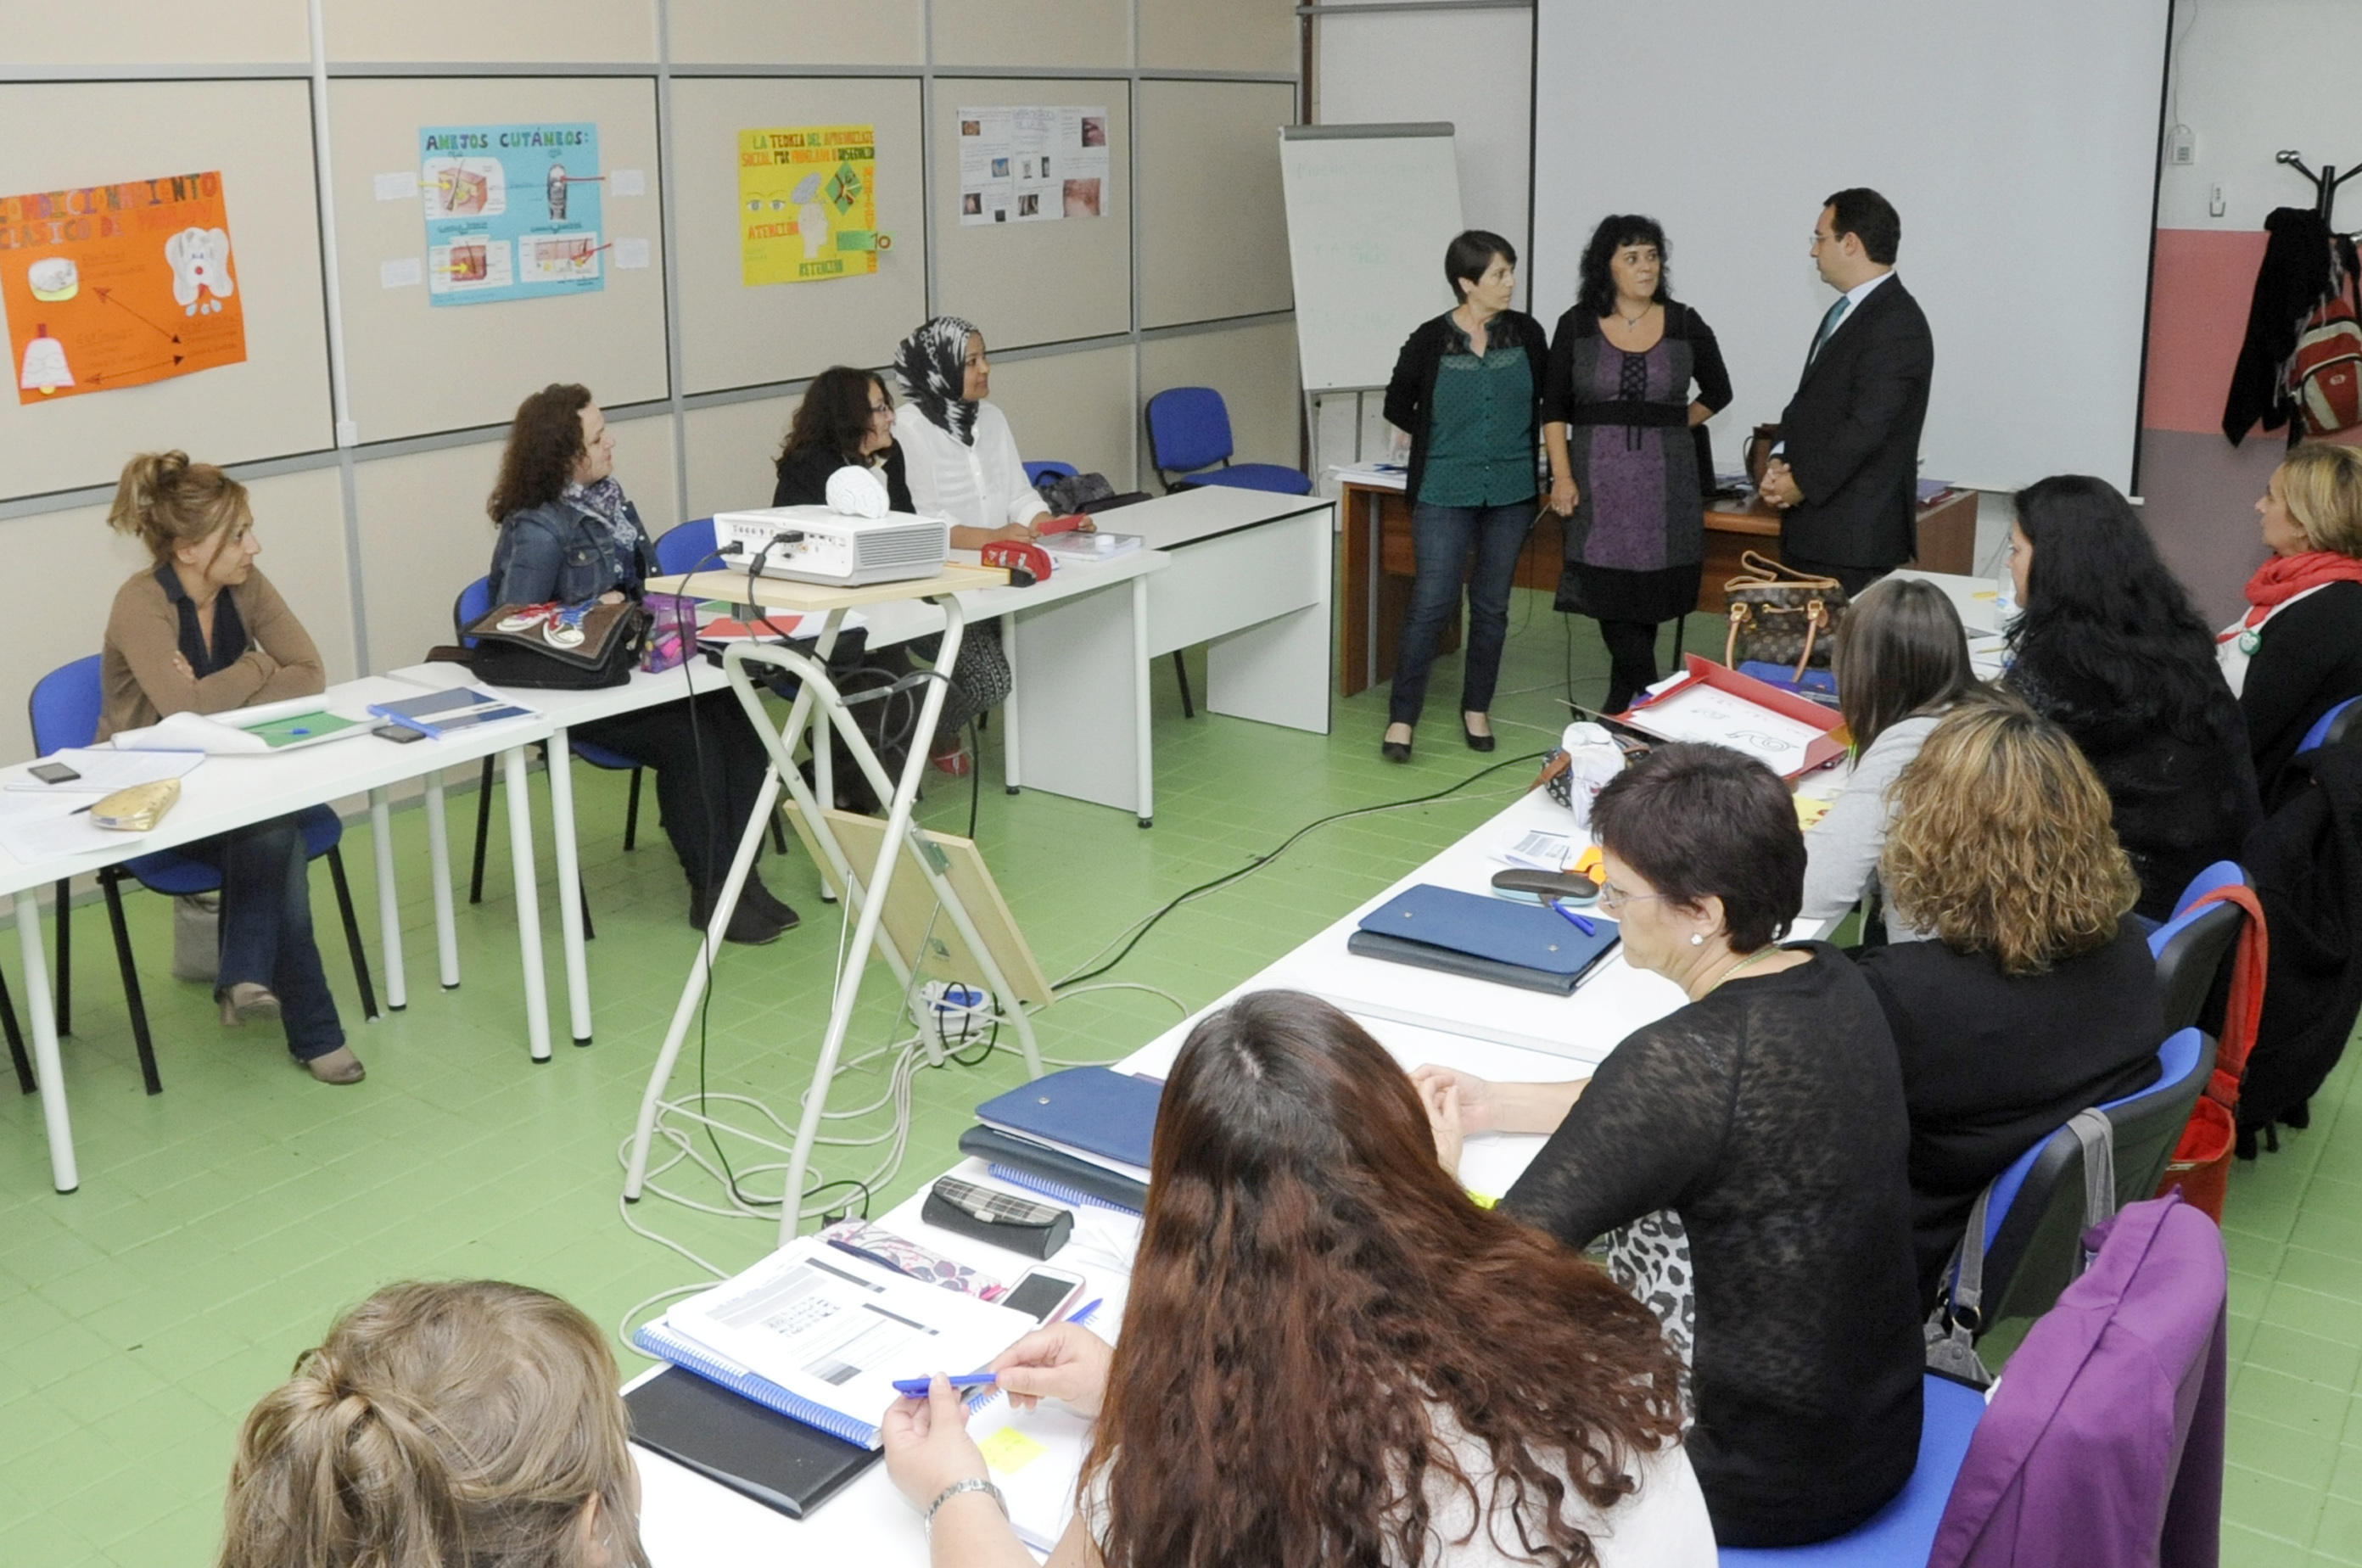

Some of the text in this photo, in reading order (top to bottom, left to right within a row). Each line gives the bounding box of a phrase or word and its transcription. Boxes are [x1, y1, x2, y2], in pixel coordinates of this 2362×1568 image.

[753, 135, 768, 149] LA
[774, 150, 790, 165] POR
[101, 215, 124, 238] DE
